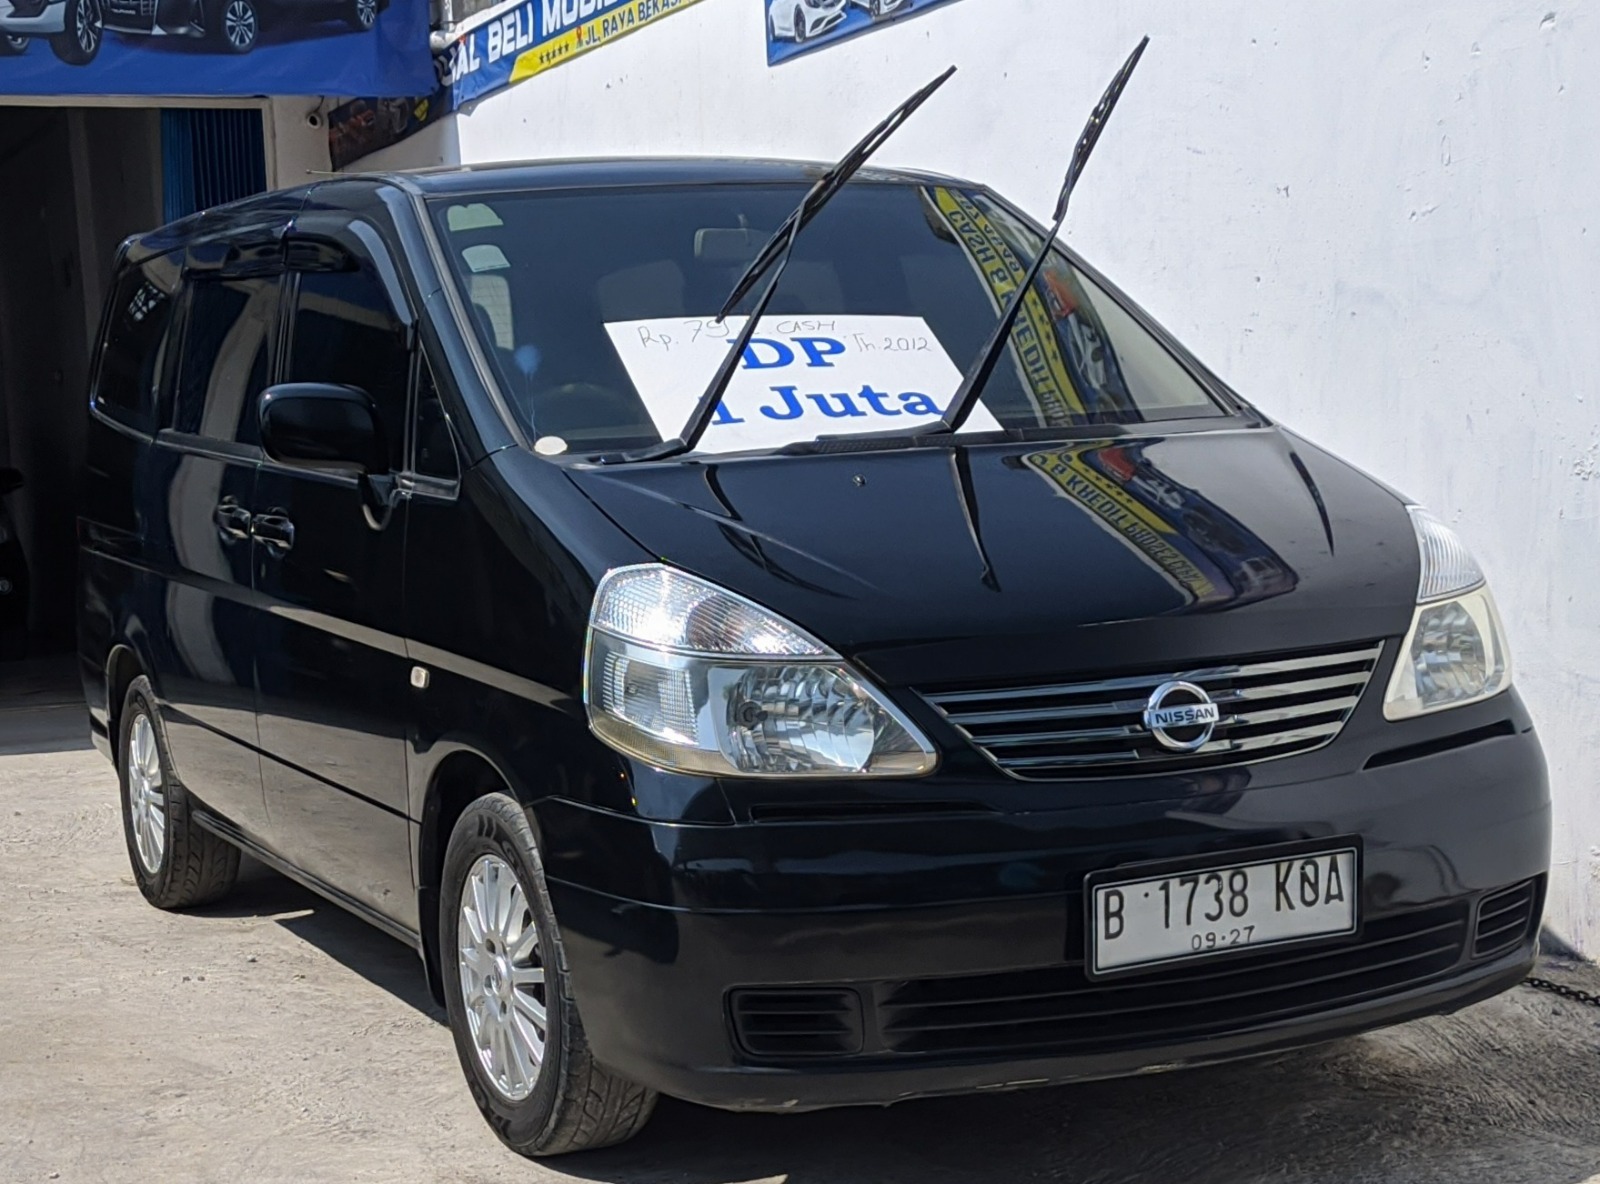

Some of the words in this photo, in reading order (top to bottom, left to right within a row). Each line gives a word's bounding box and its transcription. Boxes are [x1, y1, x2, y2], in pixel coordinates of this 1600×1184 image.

[487, 2, 534, 64] BELI
[602, 7, 635, 39] RAYA
[637, 325, 680, 351] Rp.
[776, 320, 836, 335] CASH
[726, 336, 847, 370] DP
[759, 384, 946, 421] Juta
[1155, 706, 1215, 724] NISSAN
[1104, 888, 1125, 941] B
[1158, 869, 1249, 930] 1738
